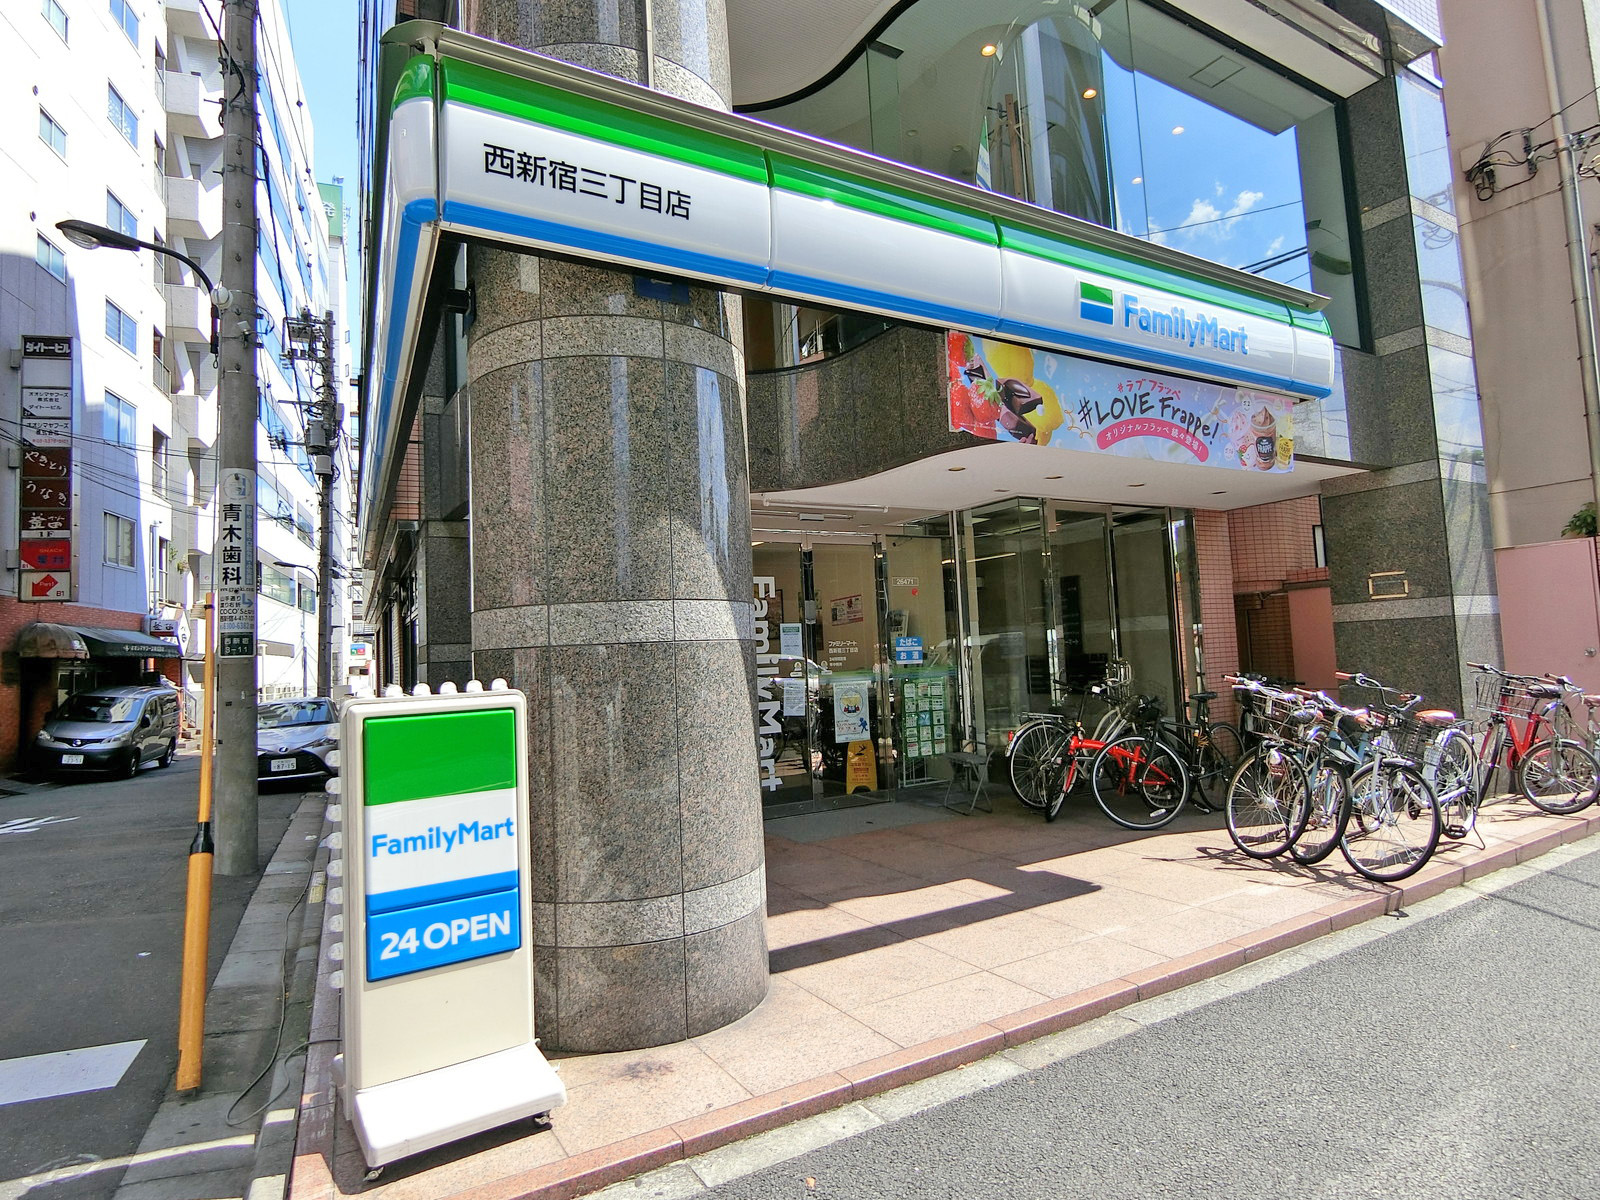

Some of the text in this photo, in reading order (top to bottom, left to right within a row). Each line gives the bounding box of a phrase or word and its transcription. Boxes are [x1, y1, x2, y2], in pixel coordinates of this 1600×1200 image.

[483, 143, 692, 221] 西新宿三丁目店
[25, 341, 71, 353] ダイトービル
[1123, 293, 1249, 355] FamilyMart
[1077, 391, 1220, 446] #LOVE Frappe!
[25, 451, 67, 477] やきとり
[26, 480, 67, 506] うなぎ
[222, 503, 242, 585] 青木歯科
[899, 638, 918, 646] たばこ
[752, 576, 783, 792] FamilyMart
[372, 817, 515, 858] FamilyMart
[380, 910, 511, 960] 24 OPEN
